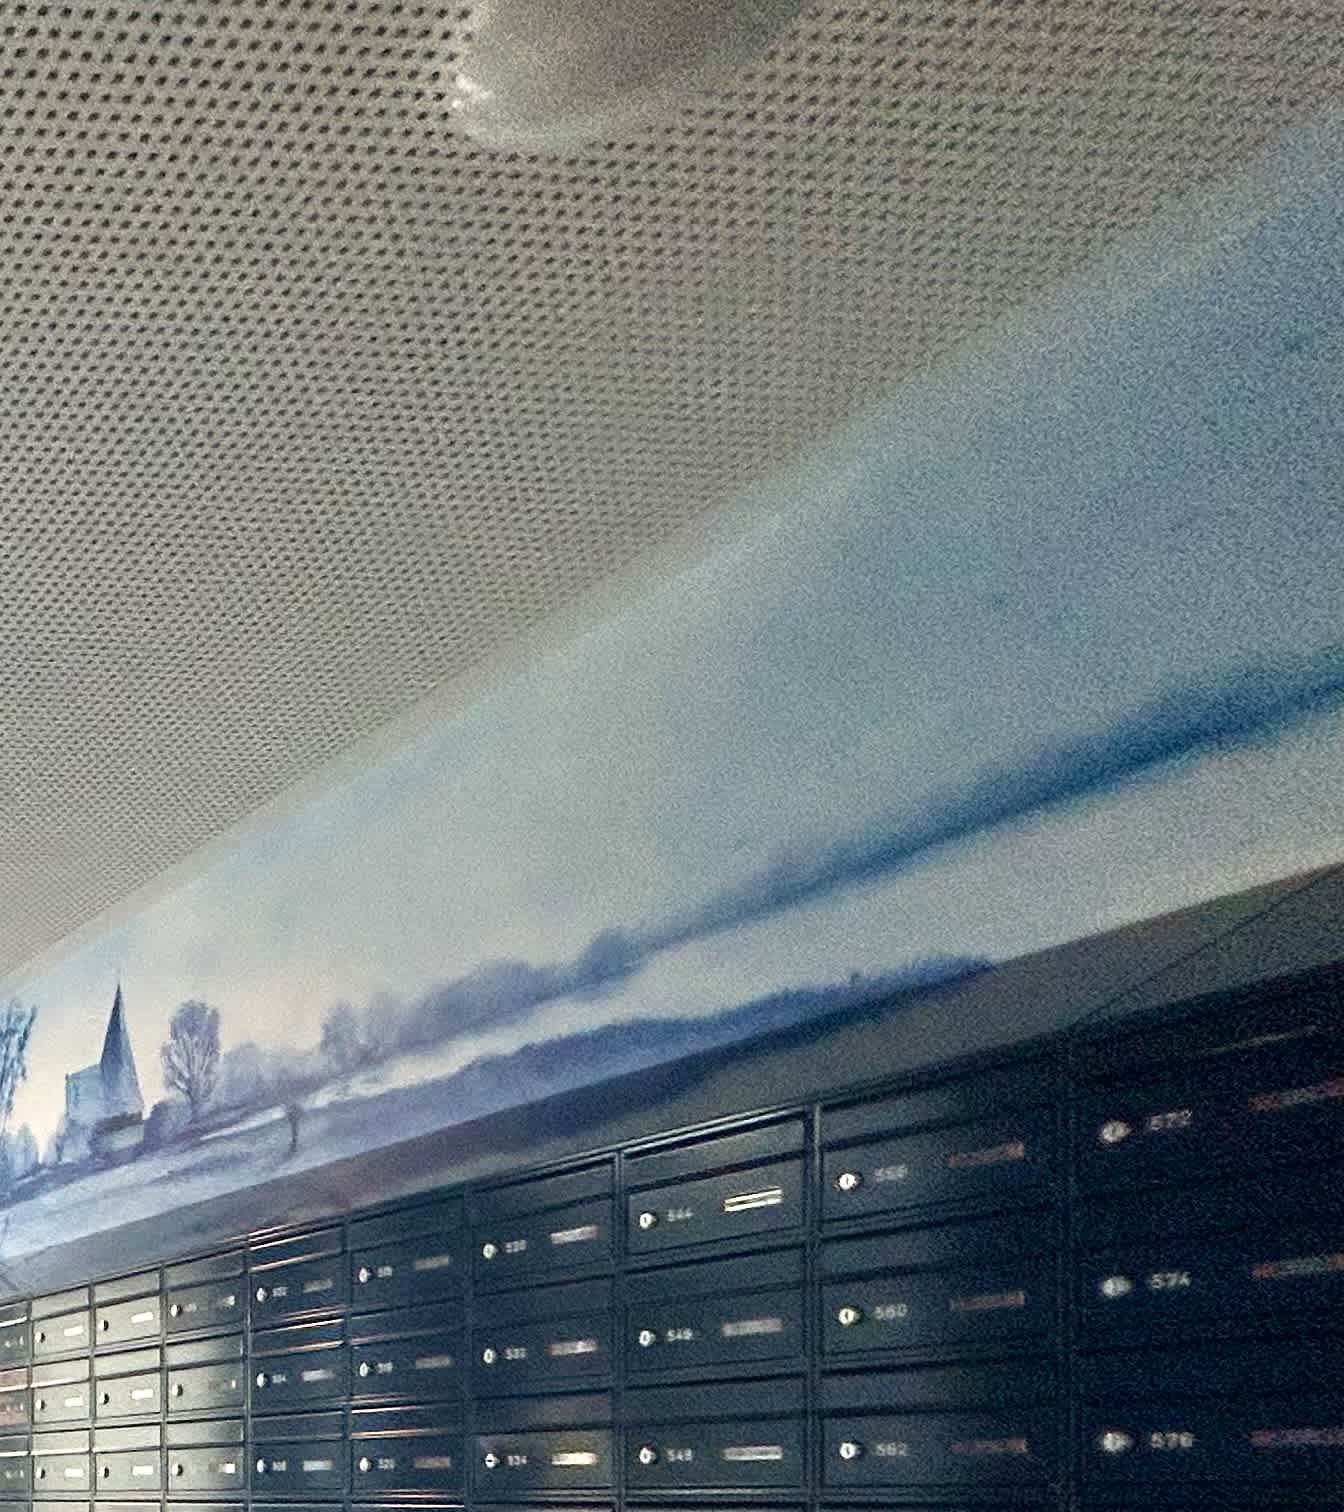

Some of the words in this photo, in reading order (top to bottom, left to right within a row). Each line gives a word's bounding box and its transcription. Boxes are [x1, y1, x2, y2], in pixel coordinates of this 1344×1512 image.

[1151, 1272, 1191, 1289] 574
[875, 1304, 907, 1320] 560
[1151, 1432, 1193, 1449] 576
[876, 1442, 908, 1457] 562
